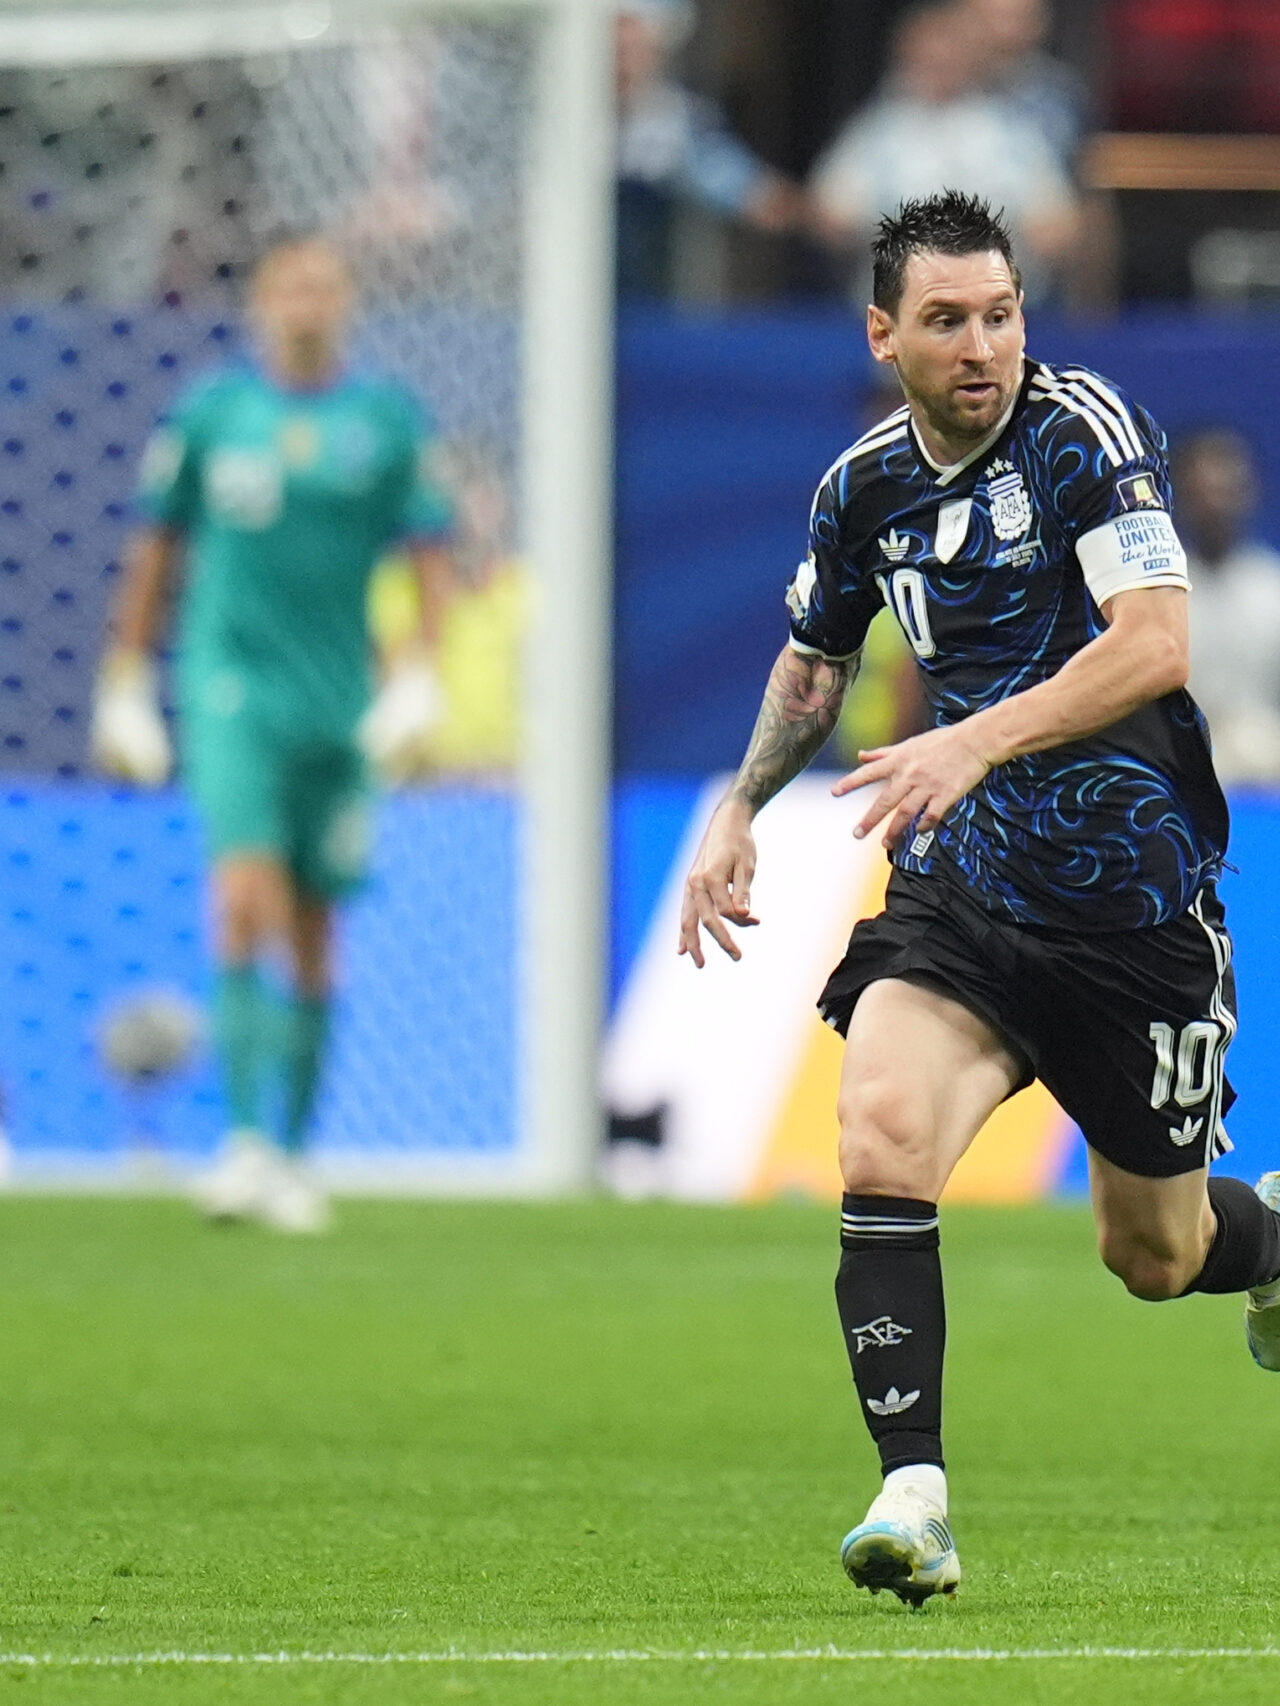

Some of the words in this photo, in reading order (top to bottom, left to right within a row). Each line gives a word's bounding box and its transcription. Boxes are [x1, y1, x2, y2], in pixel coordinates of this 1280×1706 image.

[1120, 550, 1144, 564] the
[1147, 543, 1181, 557] World
[1149, 1021, 1221, 1110] 10
